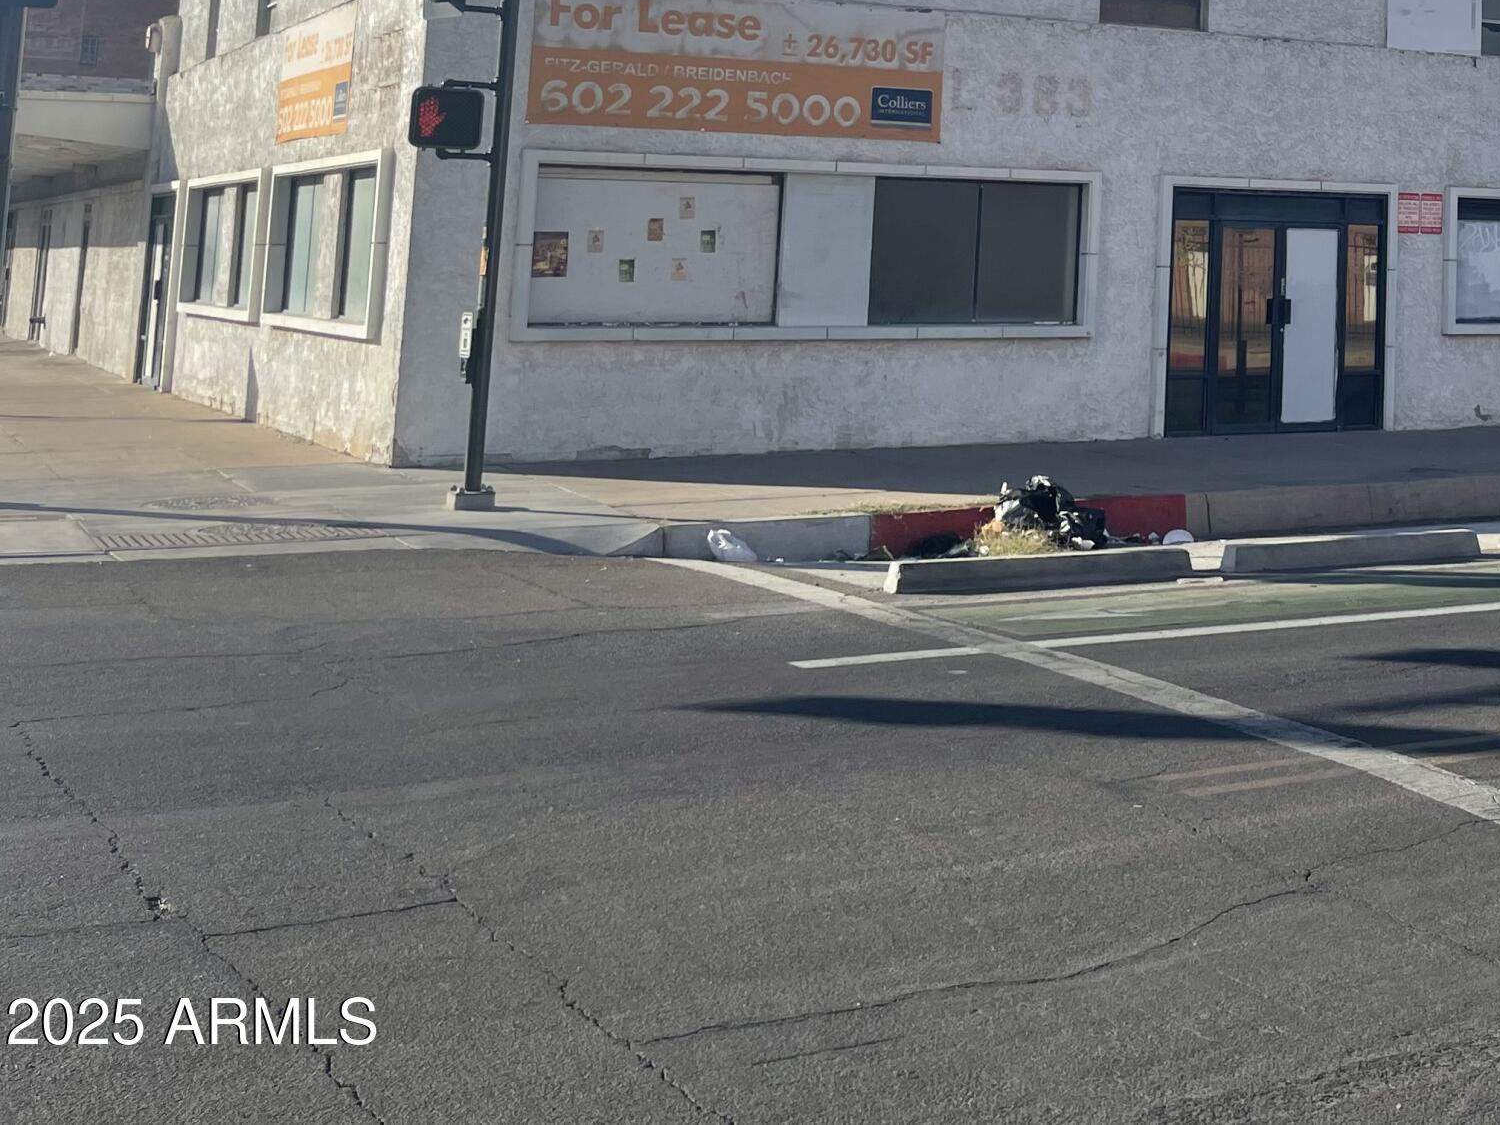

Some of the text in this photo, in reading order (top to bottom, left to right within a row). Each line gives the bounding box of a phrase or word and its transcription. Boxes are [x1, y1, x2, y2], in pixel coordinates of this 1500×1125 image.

[806, 33, 897, 64] 26,730
[904, 40, 935, 65] SF
[540, 79, 862, 127] 602 222 5000
[877, 94, 927, 111] Colliers
